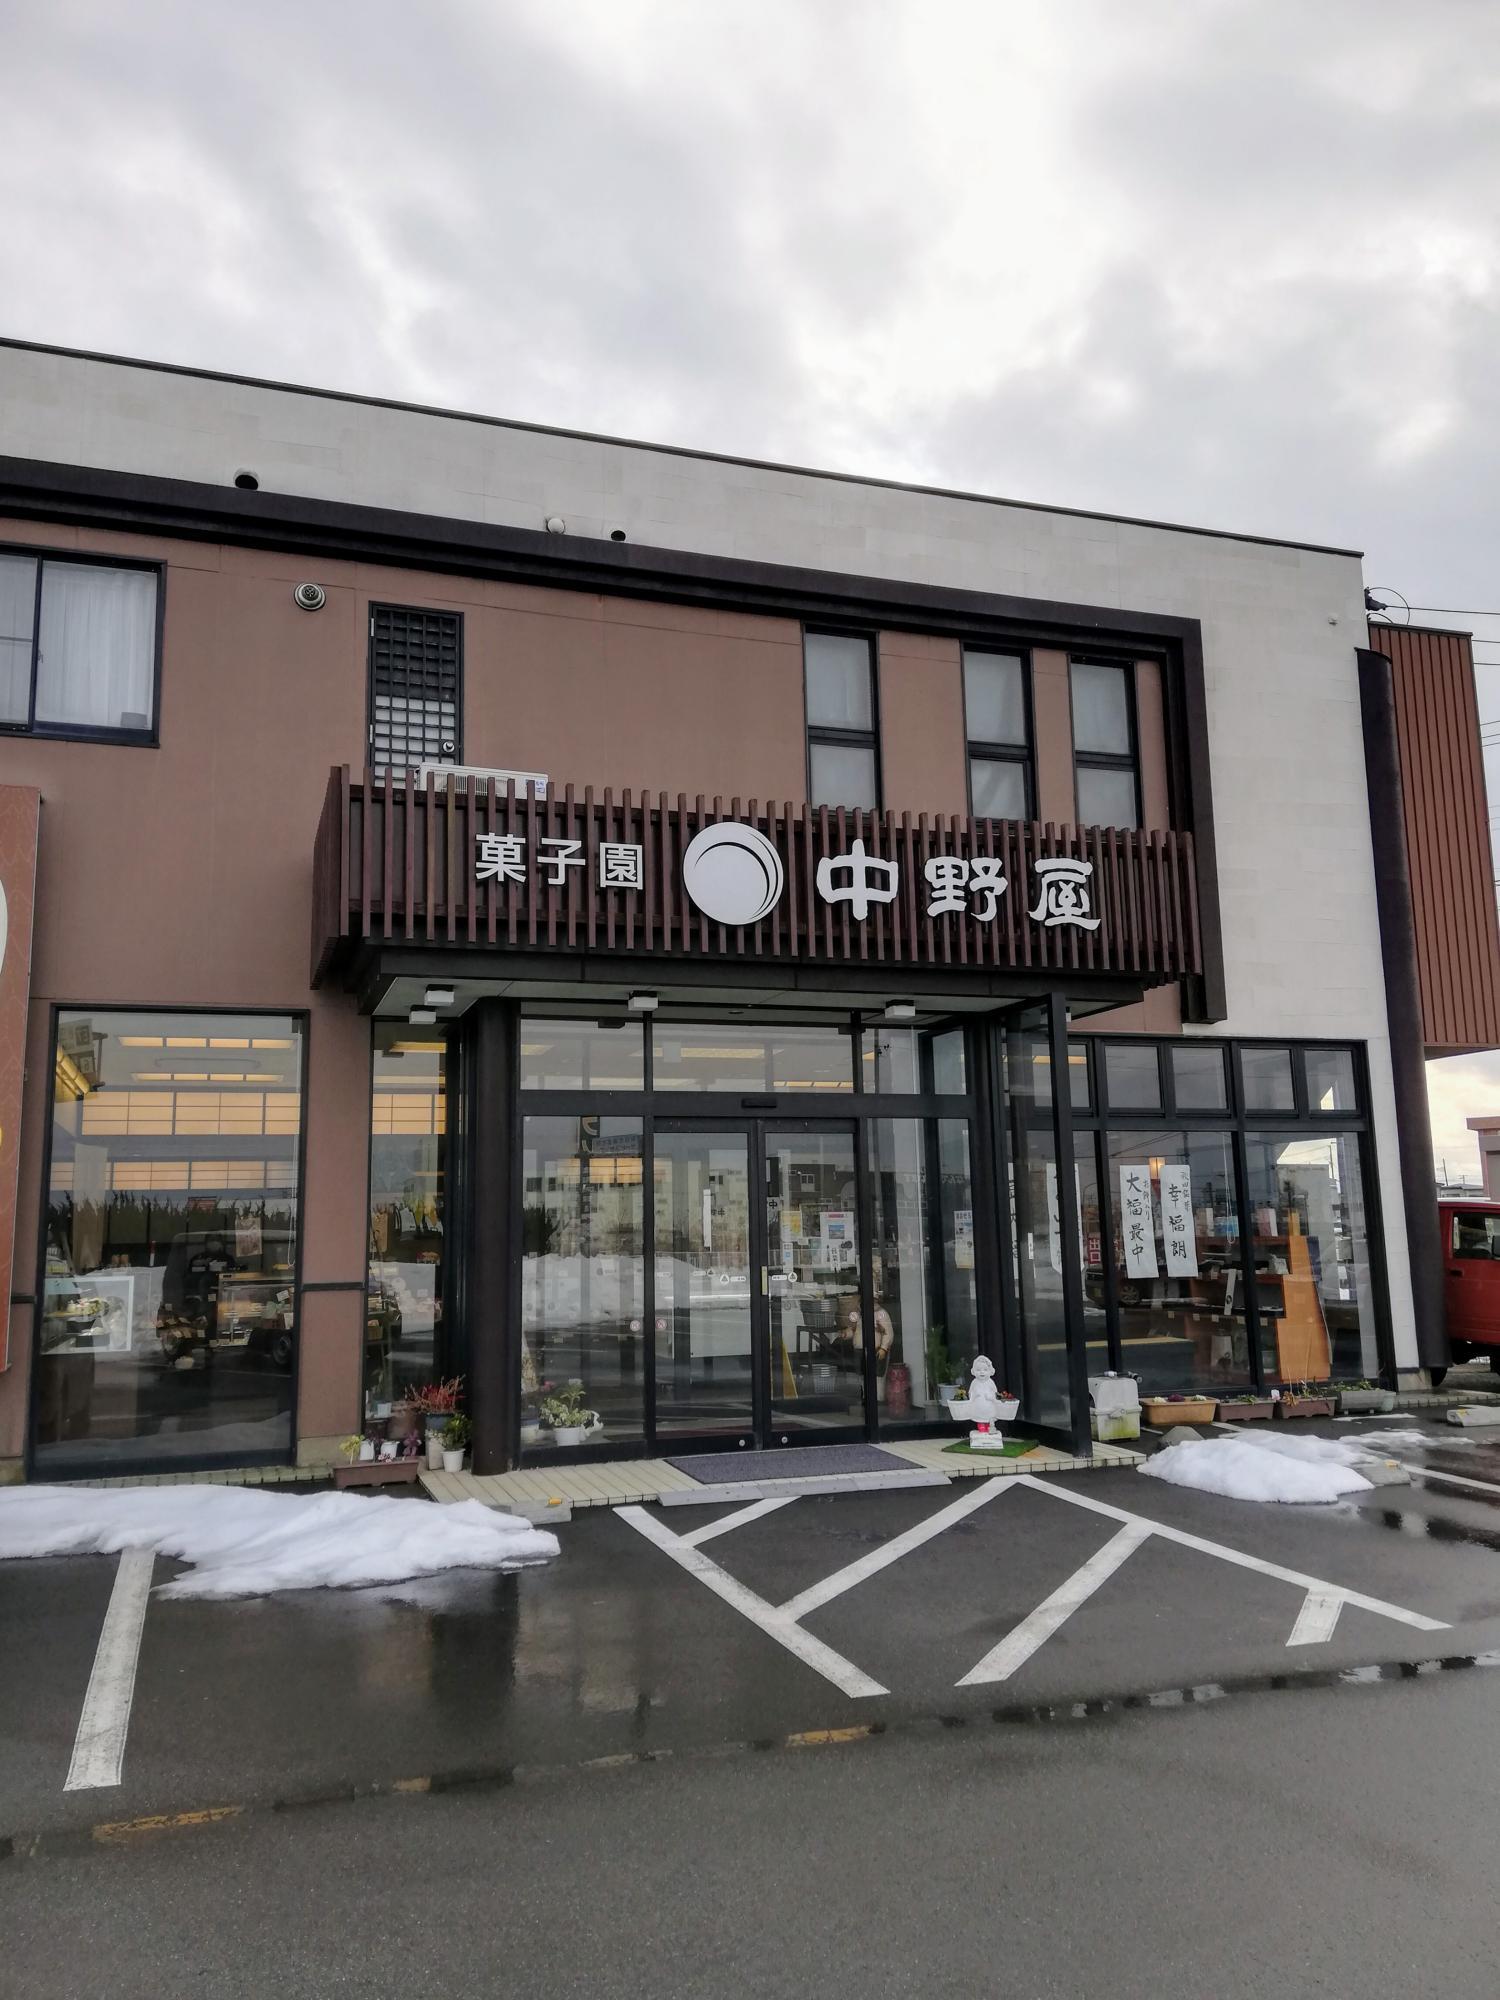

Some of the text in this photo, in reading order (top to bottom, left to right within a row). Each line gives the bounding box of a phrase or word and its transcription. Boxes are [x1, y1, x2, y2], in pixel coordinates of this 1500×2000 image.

[475, 832, 1101, 931] 菓子園 中野屋
[1126, 1172, 1145, 1265] 大福最中
[1168, 1183, 1187, 1259] 幸福朗
